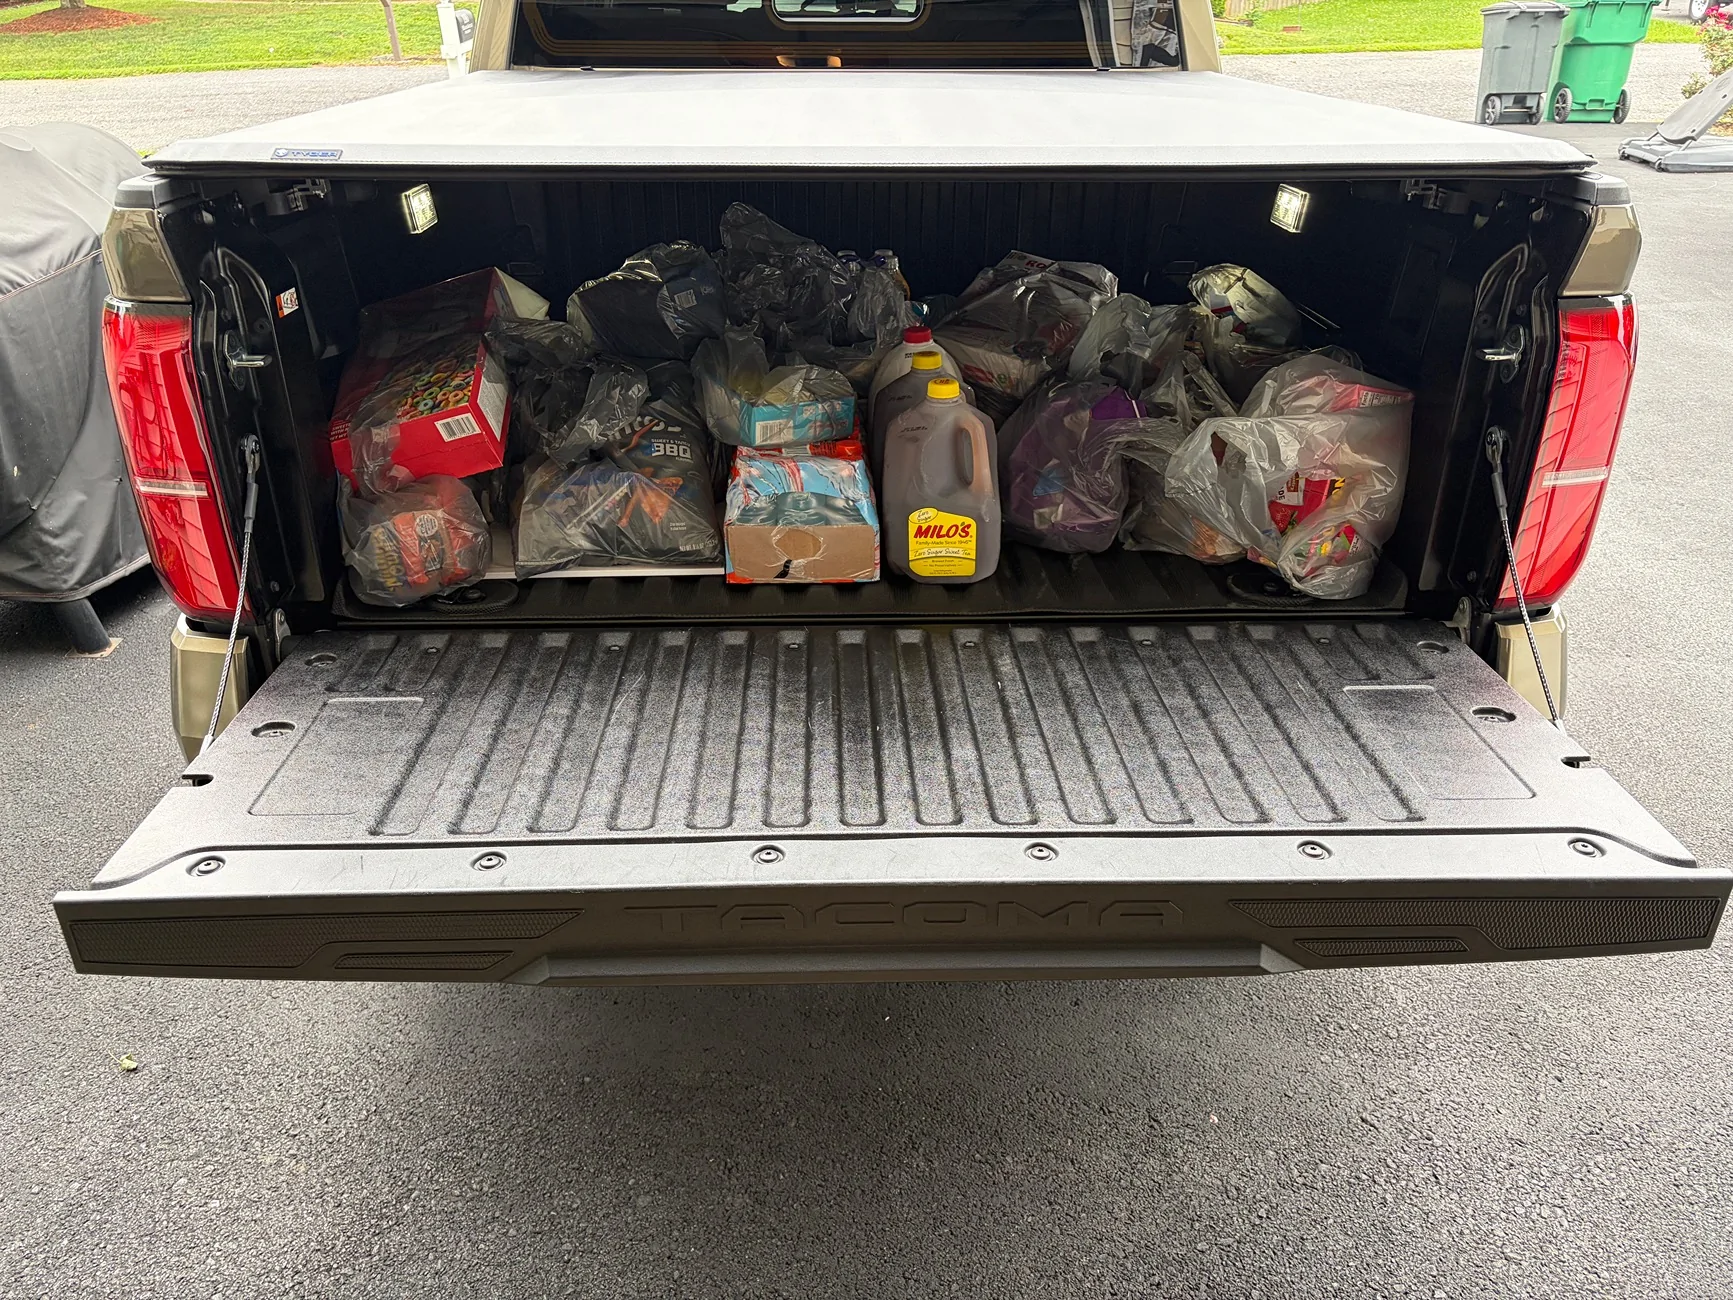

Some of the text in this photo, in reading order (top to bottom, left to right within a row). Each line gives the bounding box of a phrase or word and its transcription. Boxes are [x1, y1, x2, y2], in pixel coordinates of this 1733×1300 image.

[651, 442, 693, 459] BBQ
[913, 521, 972, 539] MILO'S
[927, 548, 943, 556] Sugar
[624, 900, 1185, 932] TACOMA
